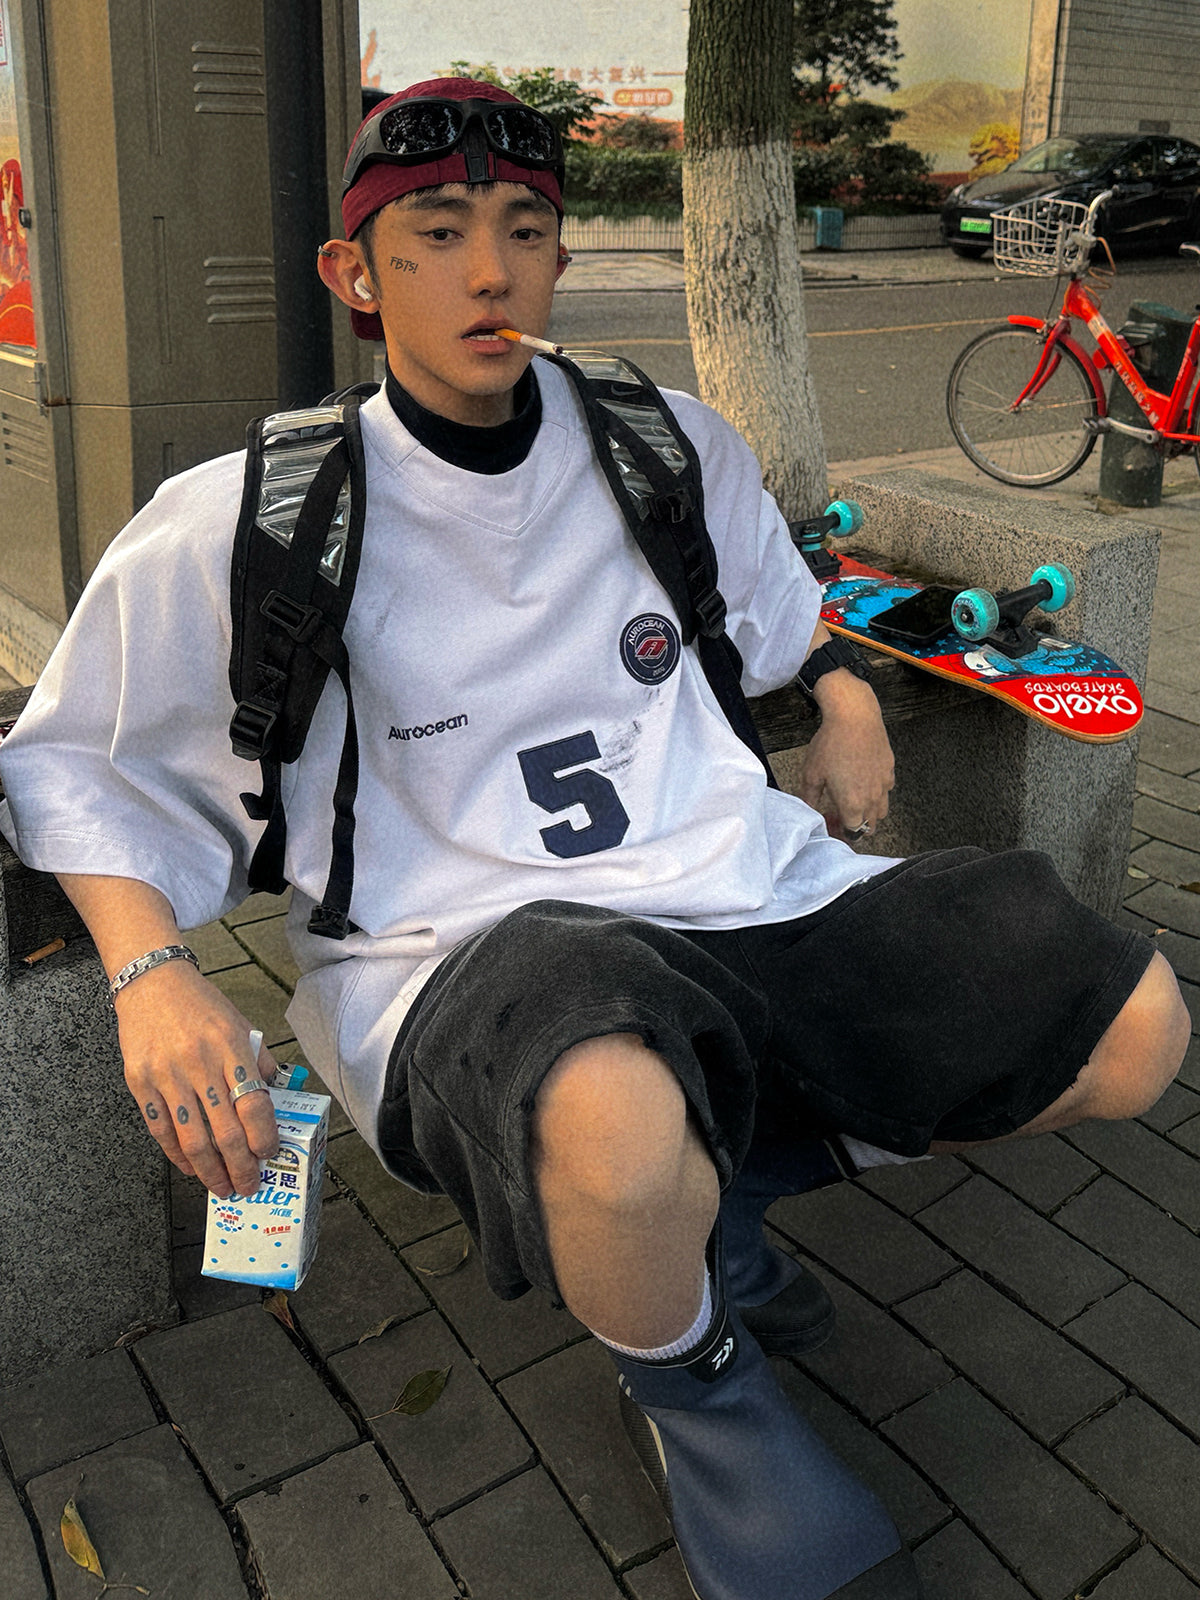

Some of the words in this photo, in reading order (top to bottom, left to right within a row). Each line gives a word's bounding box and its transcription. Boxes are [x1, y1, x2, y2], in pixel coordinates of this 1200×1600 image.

[390, 256, 419, 274] FBTS!
[627, 619, 665, 646] AUROCEAN
[1024, 681, 1125, 695] SKATEBOARDS
[1032, 693, 1138, 719] oxelo
[387, 713, 469, 741] Aurocean
[516, 729, 631, 859] 5
